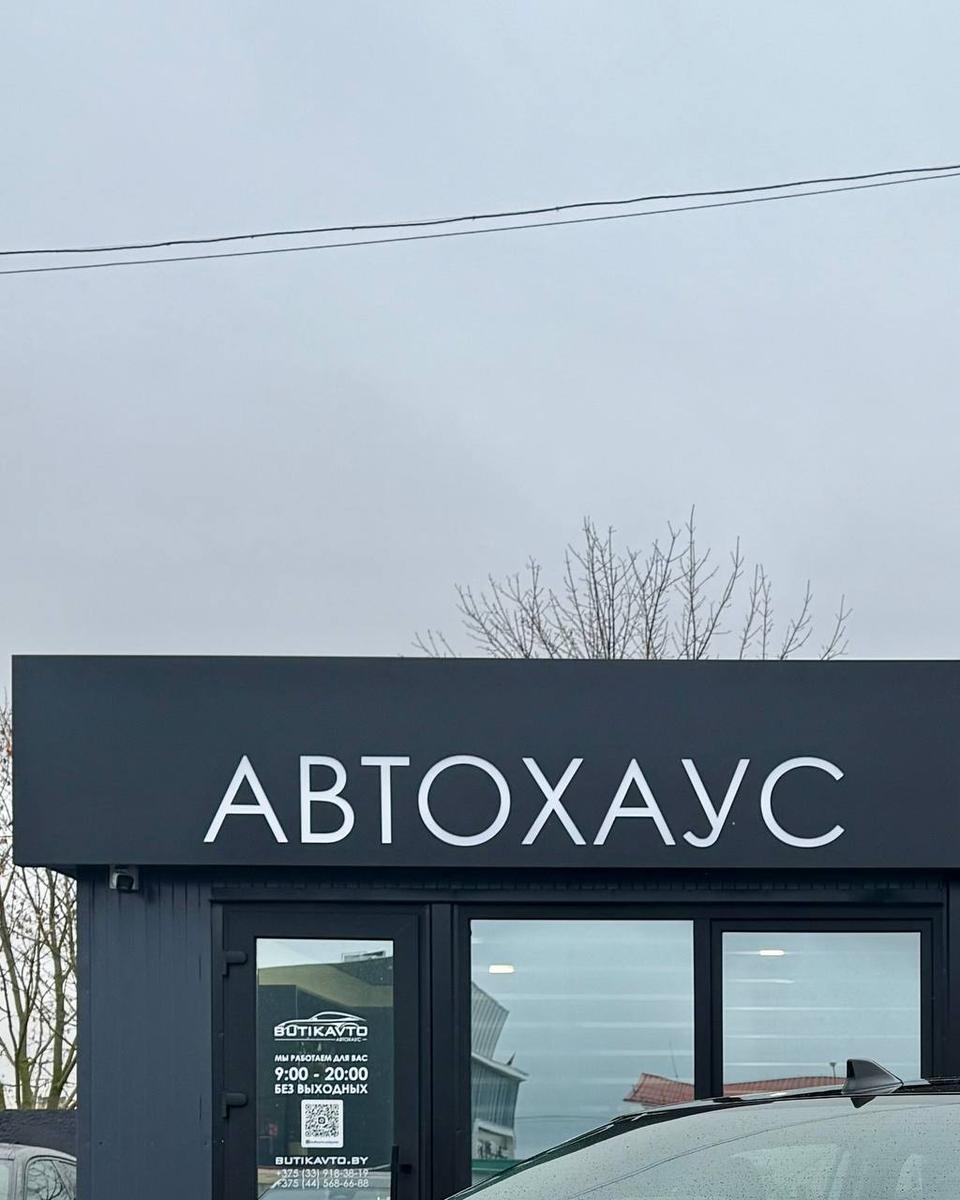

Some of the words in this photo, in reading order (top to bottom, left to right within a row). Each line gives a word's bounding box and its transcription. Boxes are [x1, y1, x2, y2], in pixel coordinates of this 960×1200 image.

[203, 754, 845, 848] АВТОХАУС
[273, 1026, 368, 1037] BUTIKAVTO
[274, 1054, 289, 1062] МЫ
[290, 1054, 332, 1062] РАБОТАЕМ
[332, 1054, 350, 1063] ДЛЯ
[351, 1054, 368, 1062] ВАС
[274, 1066, 309, 1081] 9:00
[324, 1066, 369, 1081] 20:00
[274, 1083, 294, 1094] БЕЗ
[297, 1083, 368, 1095] ВЫХОДНЫХ
[275, 1156, 369, 1165] BUTIKAVTO.BY
[276, 1168, 299, 1178] +375
[301, 1168, 320, 1179] (33)
[322, 1168, 369, 1178] 918-38-19
[276, 1179, 299, 1188] +375
[301, 1178, 320, 1189] (44)
[322, 1178, 369, 1188] 568-66-88
